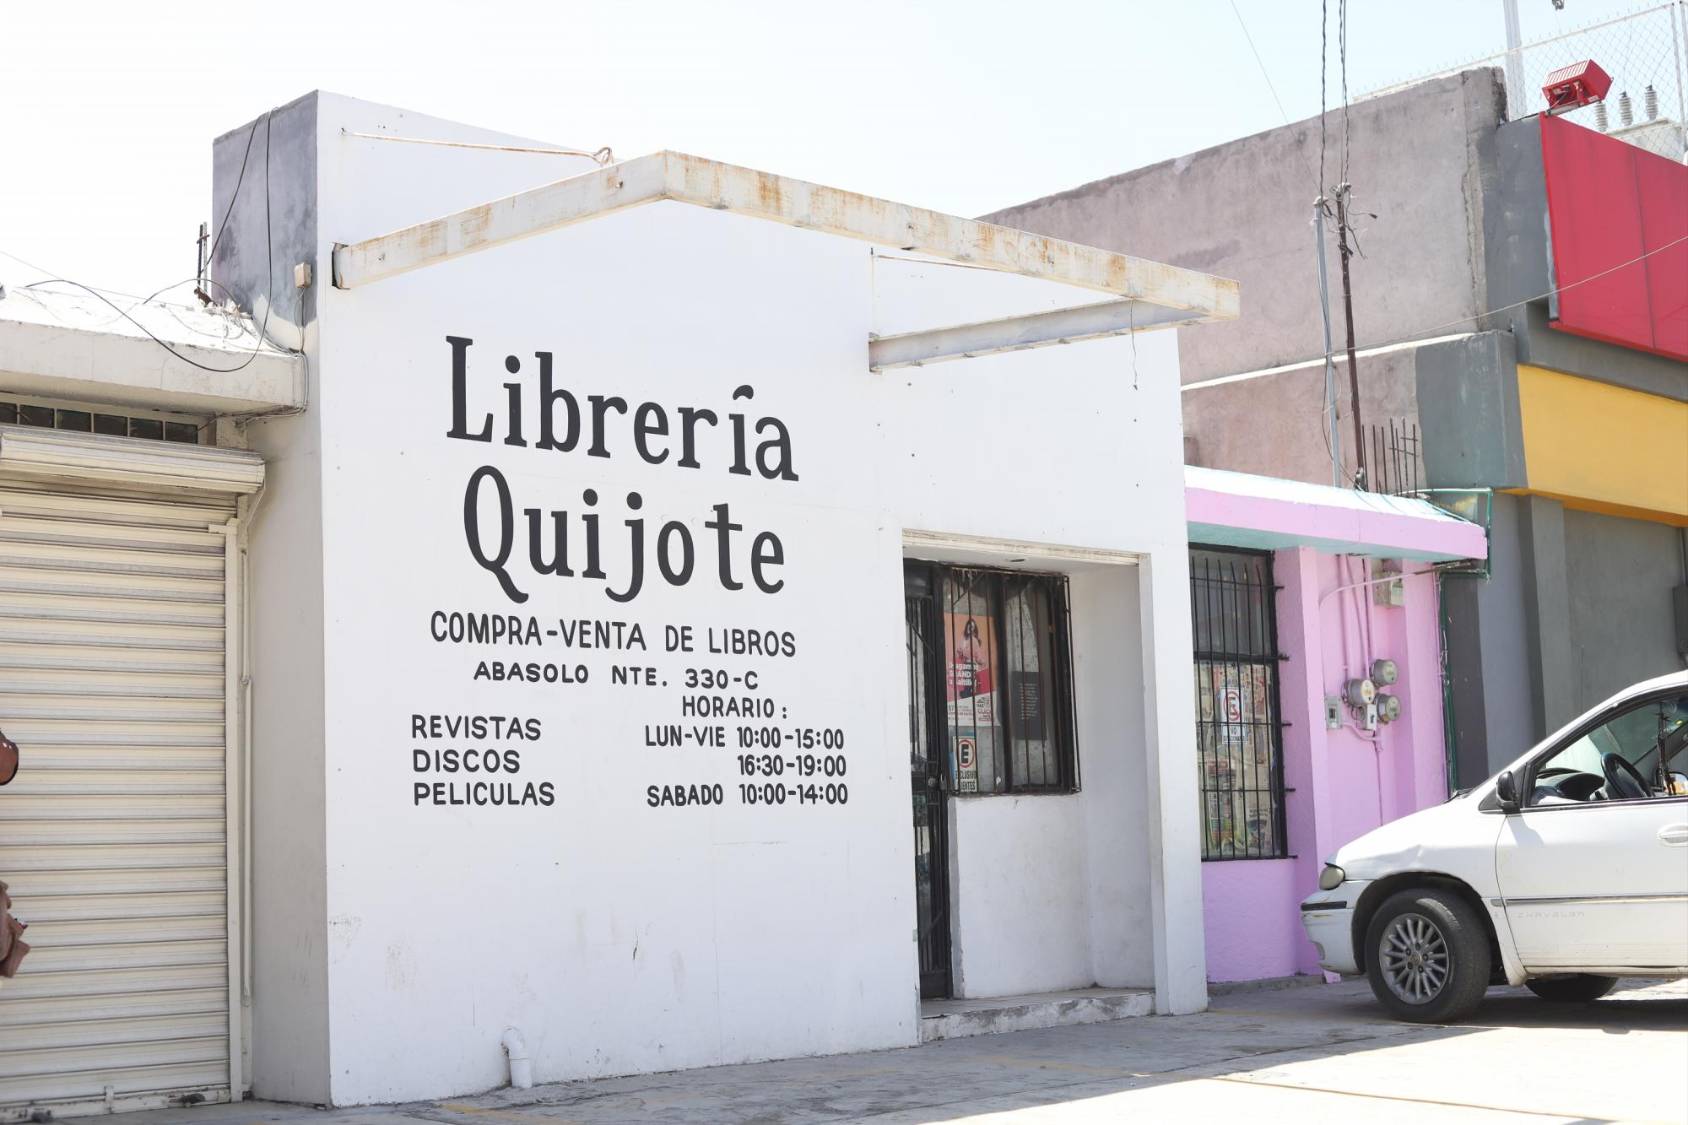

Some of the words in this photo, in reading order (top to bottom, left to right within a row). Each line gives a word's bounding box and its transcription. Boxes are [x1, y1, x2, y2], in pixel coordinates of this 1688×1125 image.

[446, 336, 799, 482] Librería
[464, 465, 785, 604] Quijote
[431, 610, 647, 651] COMPRA-VENTA
[665, 624, 694, 652] DE
[708, 627, 796, 658] LIBROS
[474, 661, 589, 684] ABASOLO
[611, 666, 668, 687] NTE.
[685, 668, 758, 690] 330-C
[411, 714, 542, 741] REVISTAS
[645, 725, 726, 748] LUN-VIE
[736, 726, 844, 750] 10:00-15:00
[413, 748, 520, 774] DISCOS
[737, 754, 847, 777] 16:30-19:00
[961, 743, 970, 764] E
[414, 781, 555, 807] PELICULAS
[647, 783, 724, 808] SABADO
[739, 782, 848, 806] 10:00-14:00
